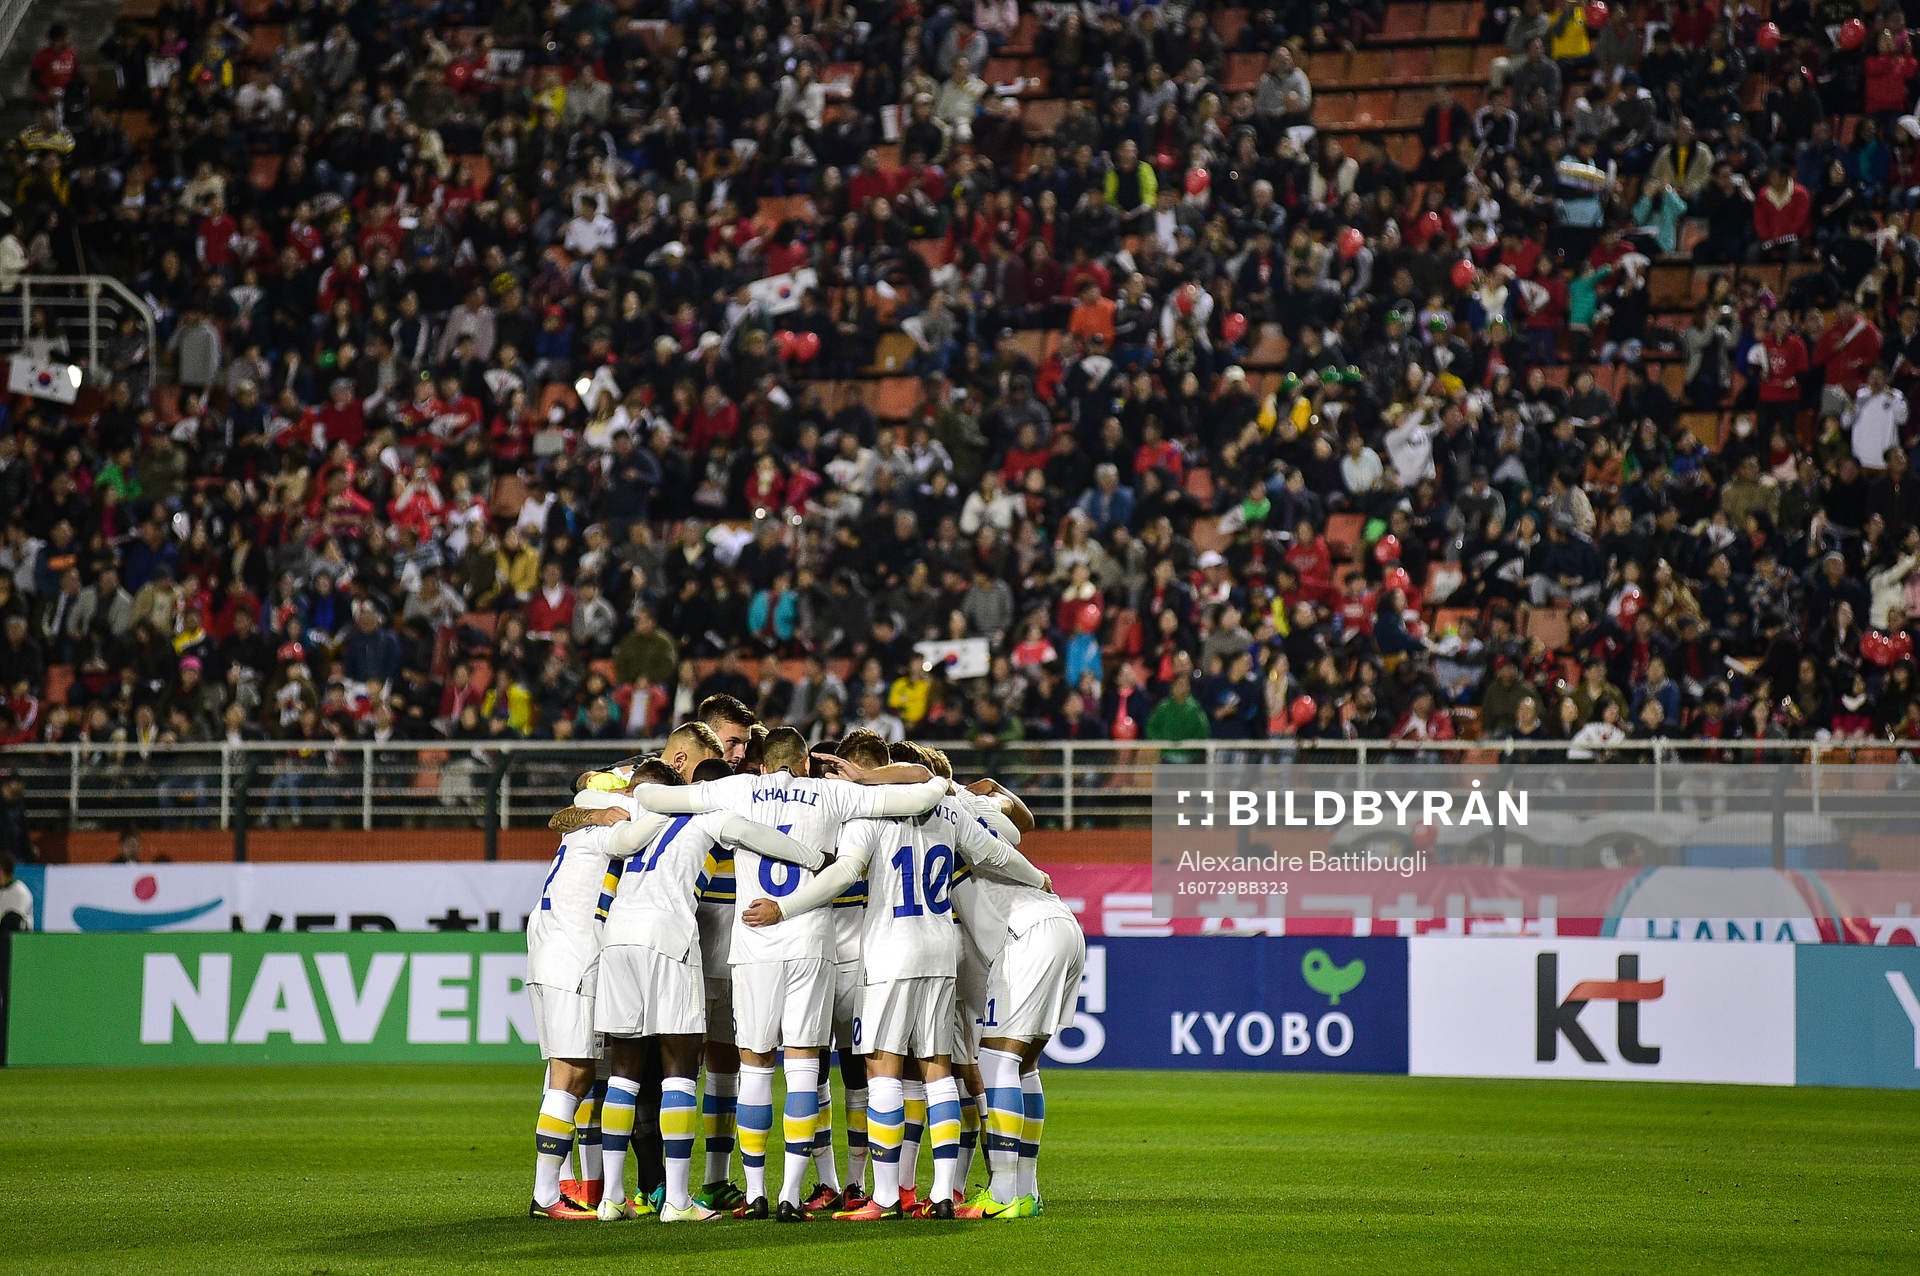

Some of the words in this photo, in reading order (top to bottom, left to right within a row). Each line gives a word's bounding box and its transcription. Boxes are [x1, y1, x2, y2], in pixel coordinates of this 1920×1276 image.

[752, 787, 819, 807] KHALILI
[891, 844, 952, 919] 10
[140, 952, 541, 1044] NAVER
[1170, 1011, 1354, 1057] KYOBO
[1537, 953, 1665, 1064] kt
